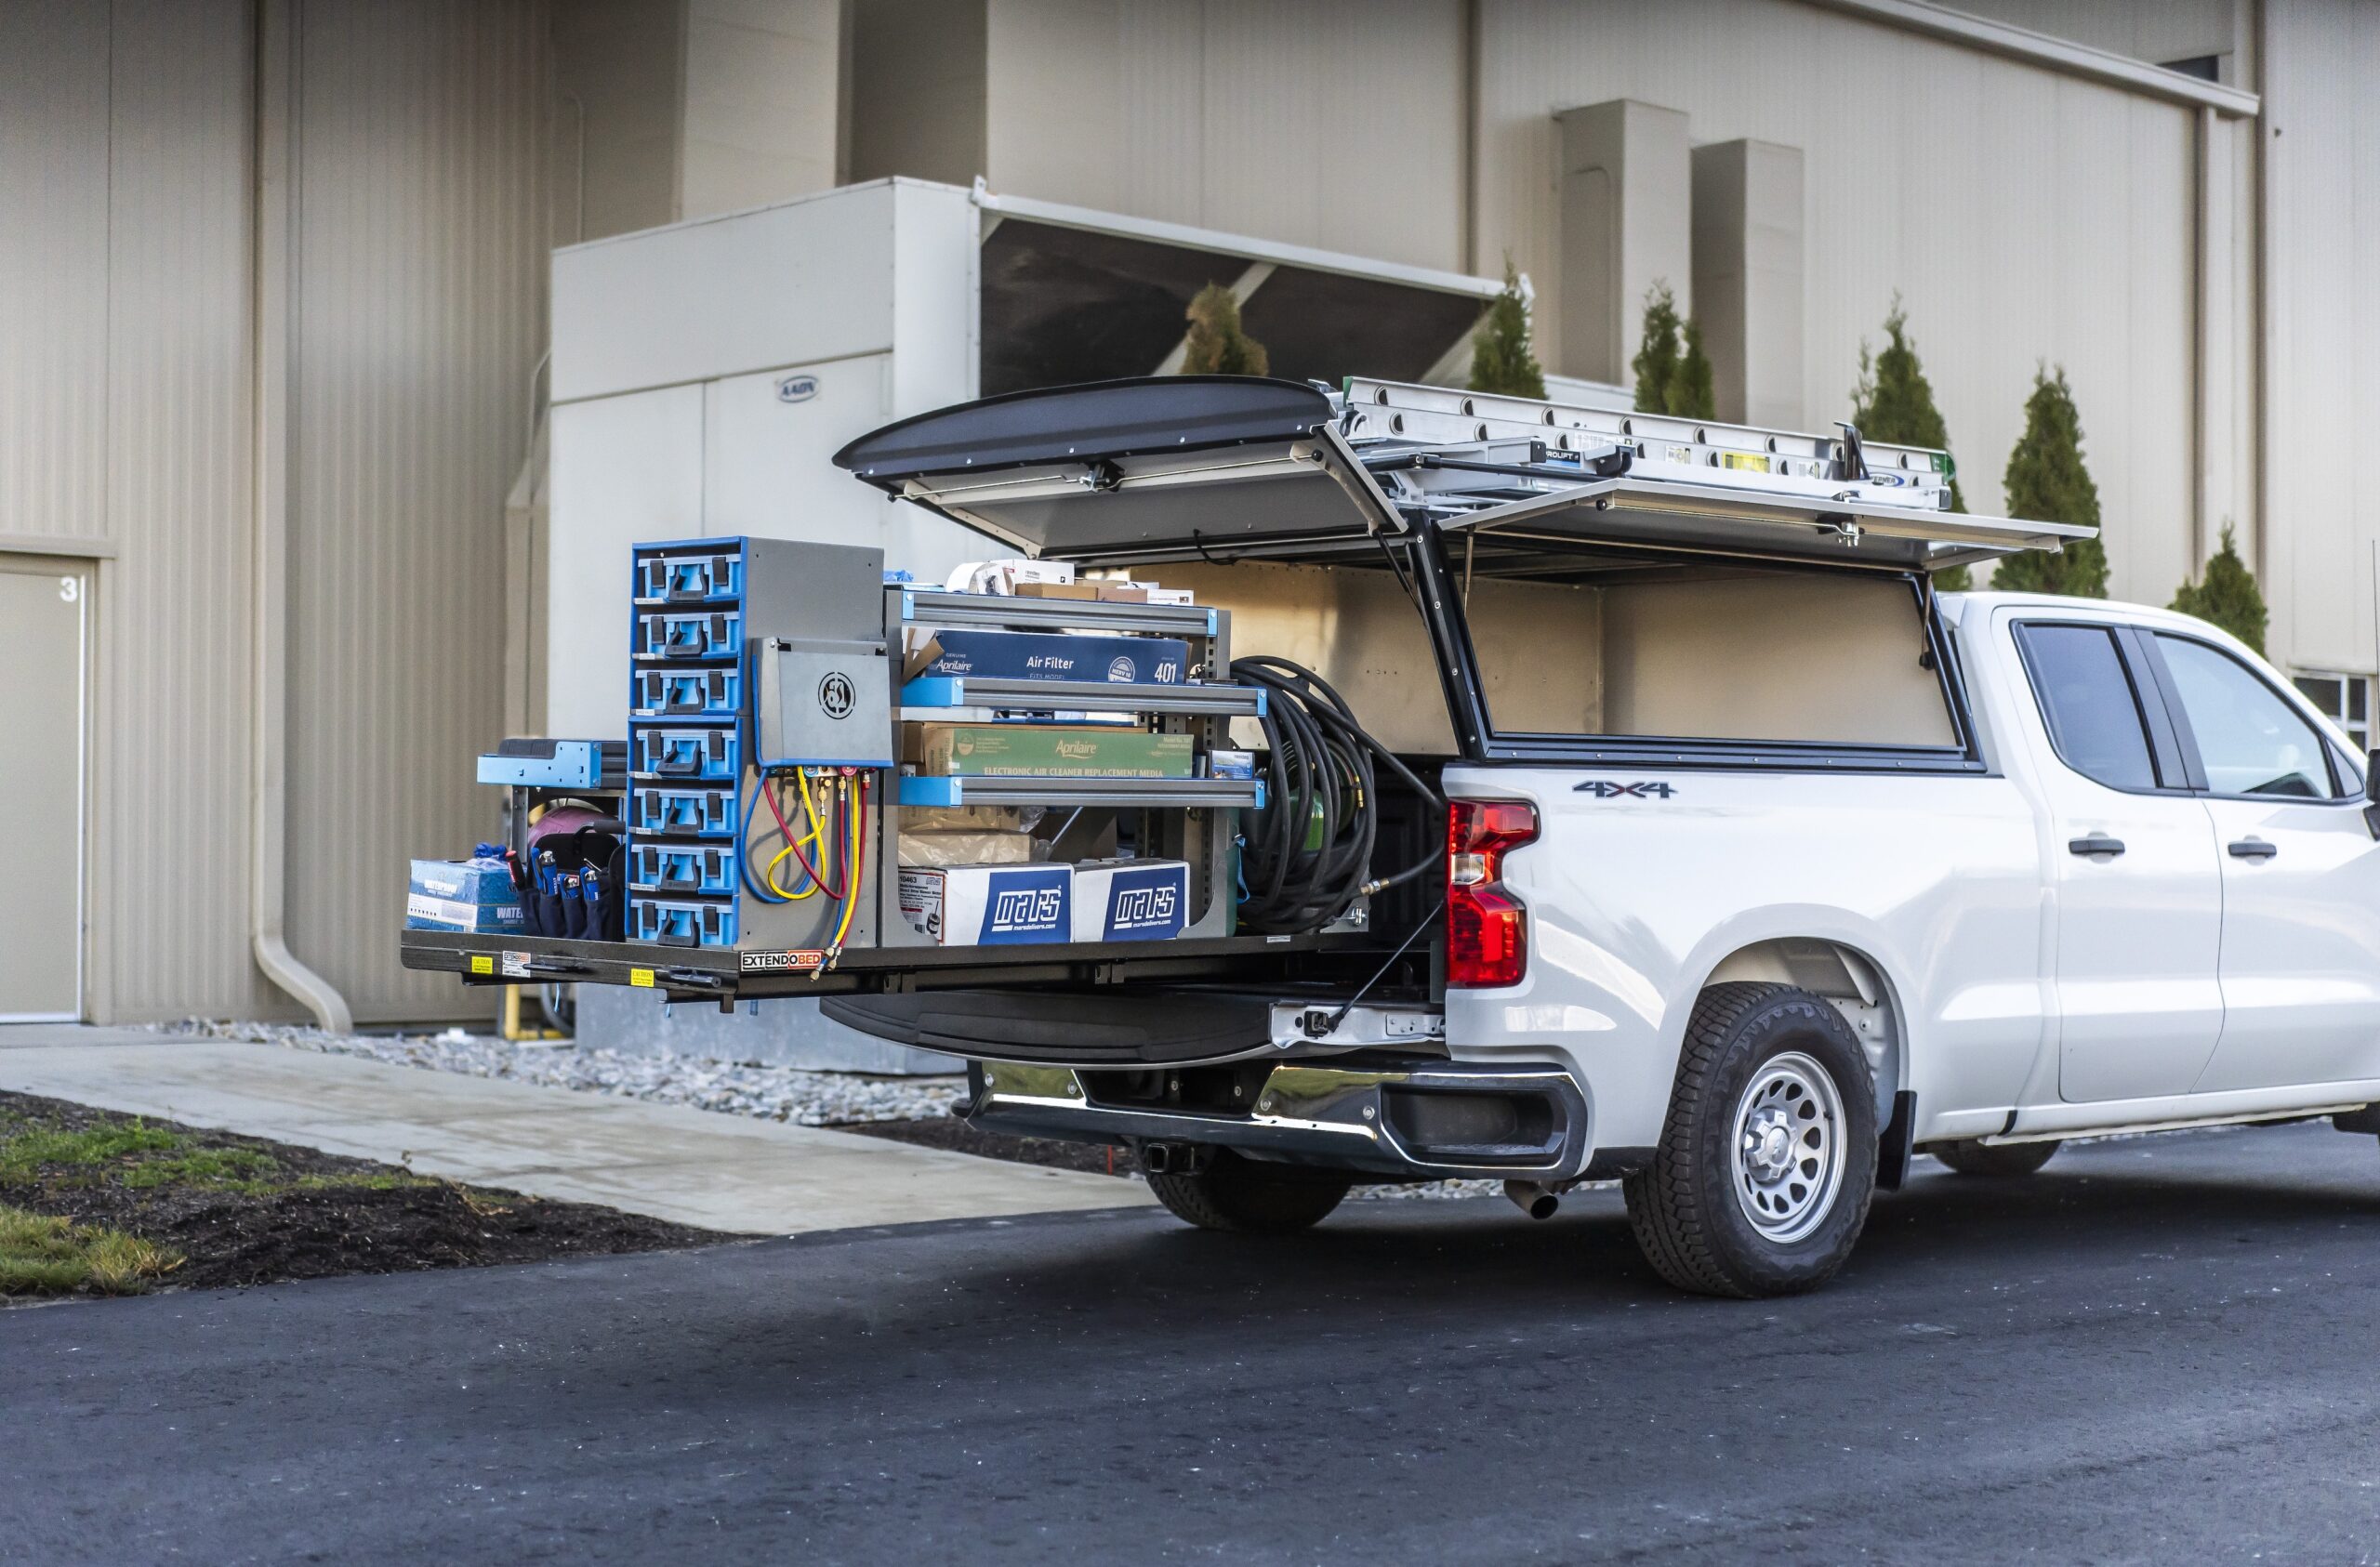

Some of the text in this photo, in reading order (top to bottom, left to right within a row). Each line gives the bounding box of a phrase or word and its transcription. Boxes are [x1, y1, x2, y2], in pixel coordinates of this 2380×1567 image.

[1546, 451, 1573, 460] ROLIFT
[59, 575, 79, 603] 3
[935, 658, 972, 674] Aprilaire
[1026, 655, 1074, 669] Air Filter
[1154, 663, 1177, 683] 401
[1055, 739, 1097, 758] Aprilaire
[985, 767, 1164, 778] ELECTRONIC AIR CLEANER REPLACEMENT MEDIA
[899, 876, 917, 884] 10463
[1132, 919, 1171, 928] marsdelivers.com
[743, 954, 821, 967] EXTENDOBED
